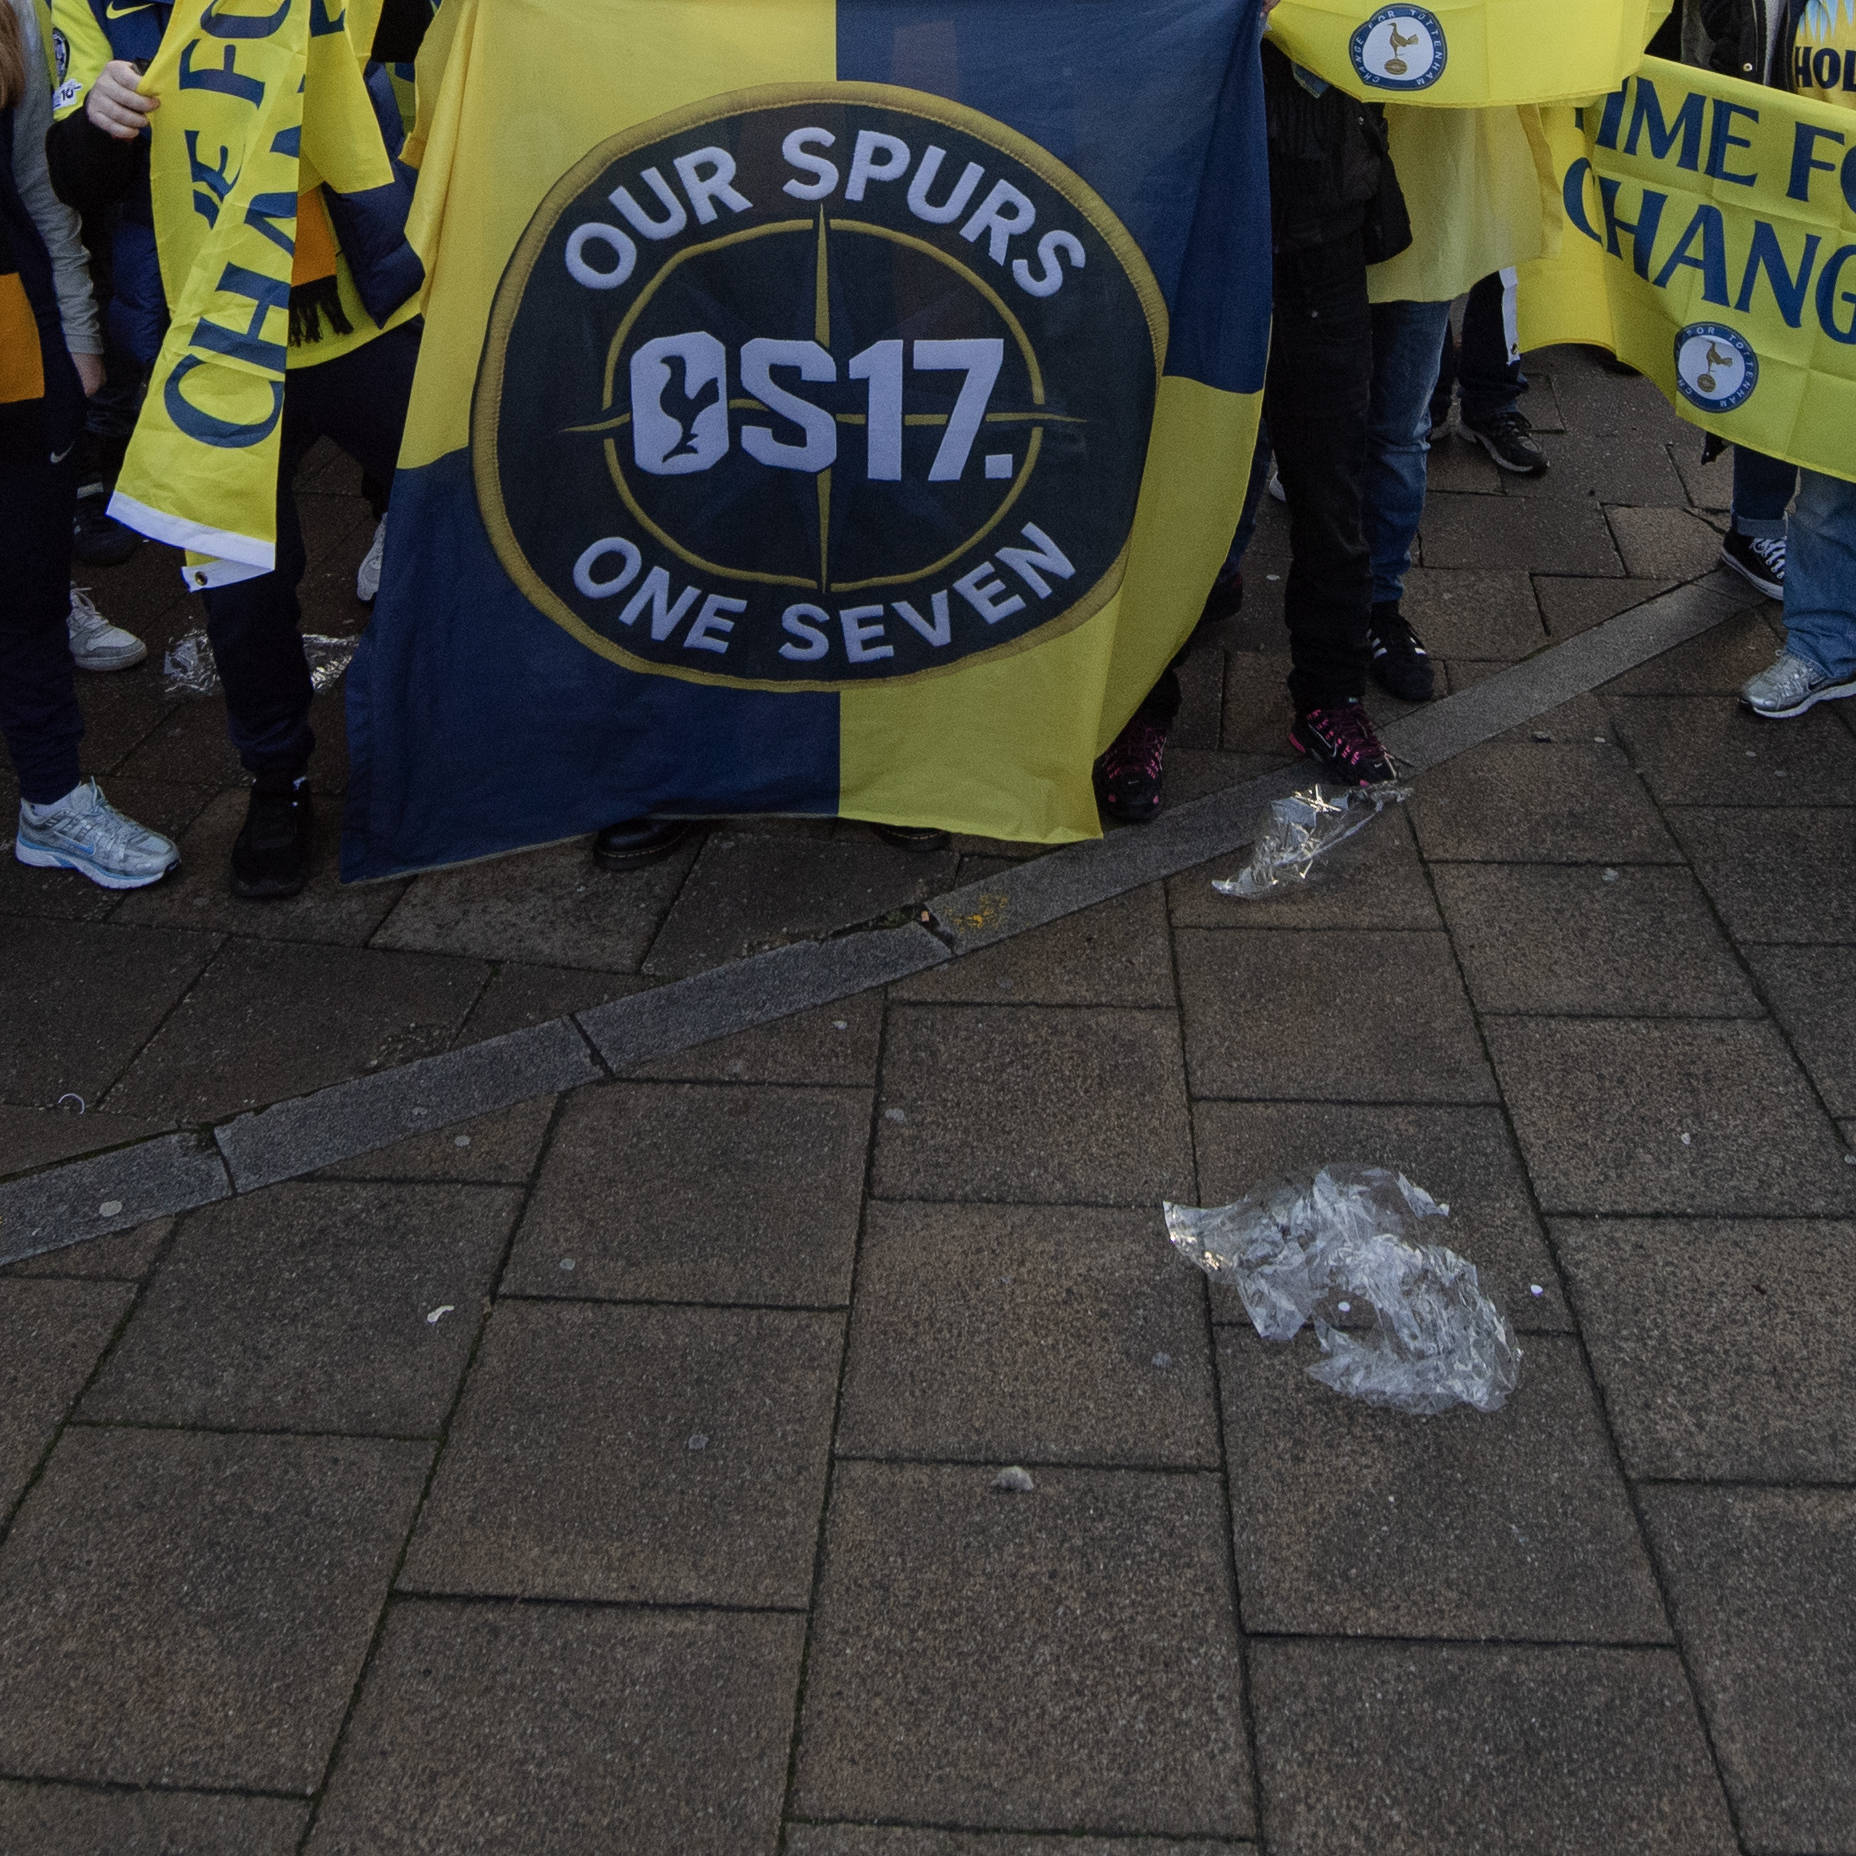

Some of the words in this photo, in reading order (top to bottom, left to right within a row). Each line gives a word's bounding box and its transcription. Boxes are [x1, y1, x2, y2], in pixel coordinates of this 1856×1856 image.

[1408, 8, 1444, 86] TOTTENHAM
[1574, 76, 1760, 188] IME
[564, 145, 754, 292] OUR
[780, 126, 1086, 297] SPURS
[572, 536, 749, 656] ONE
[779, 521, 1078, 666] SEVEN
